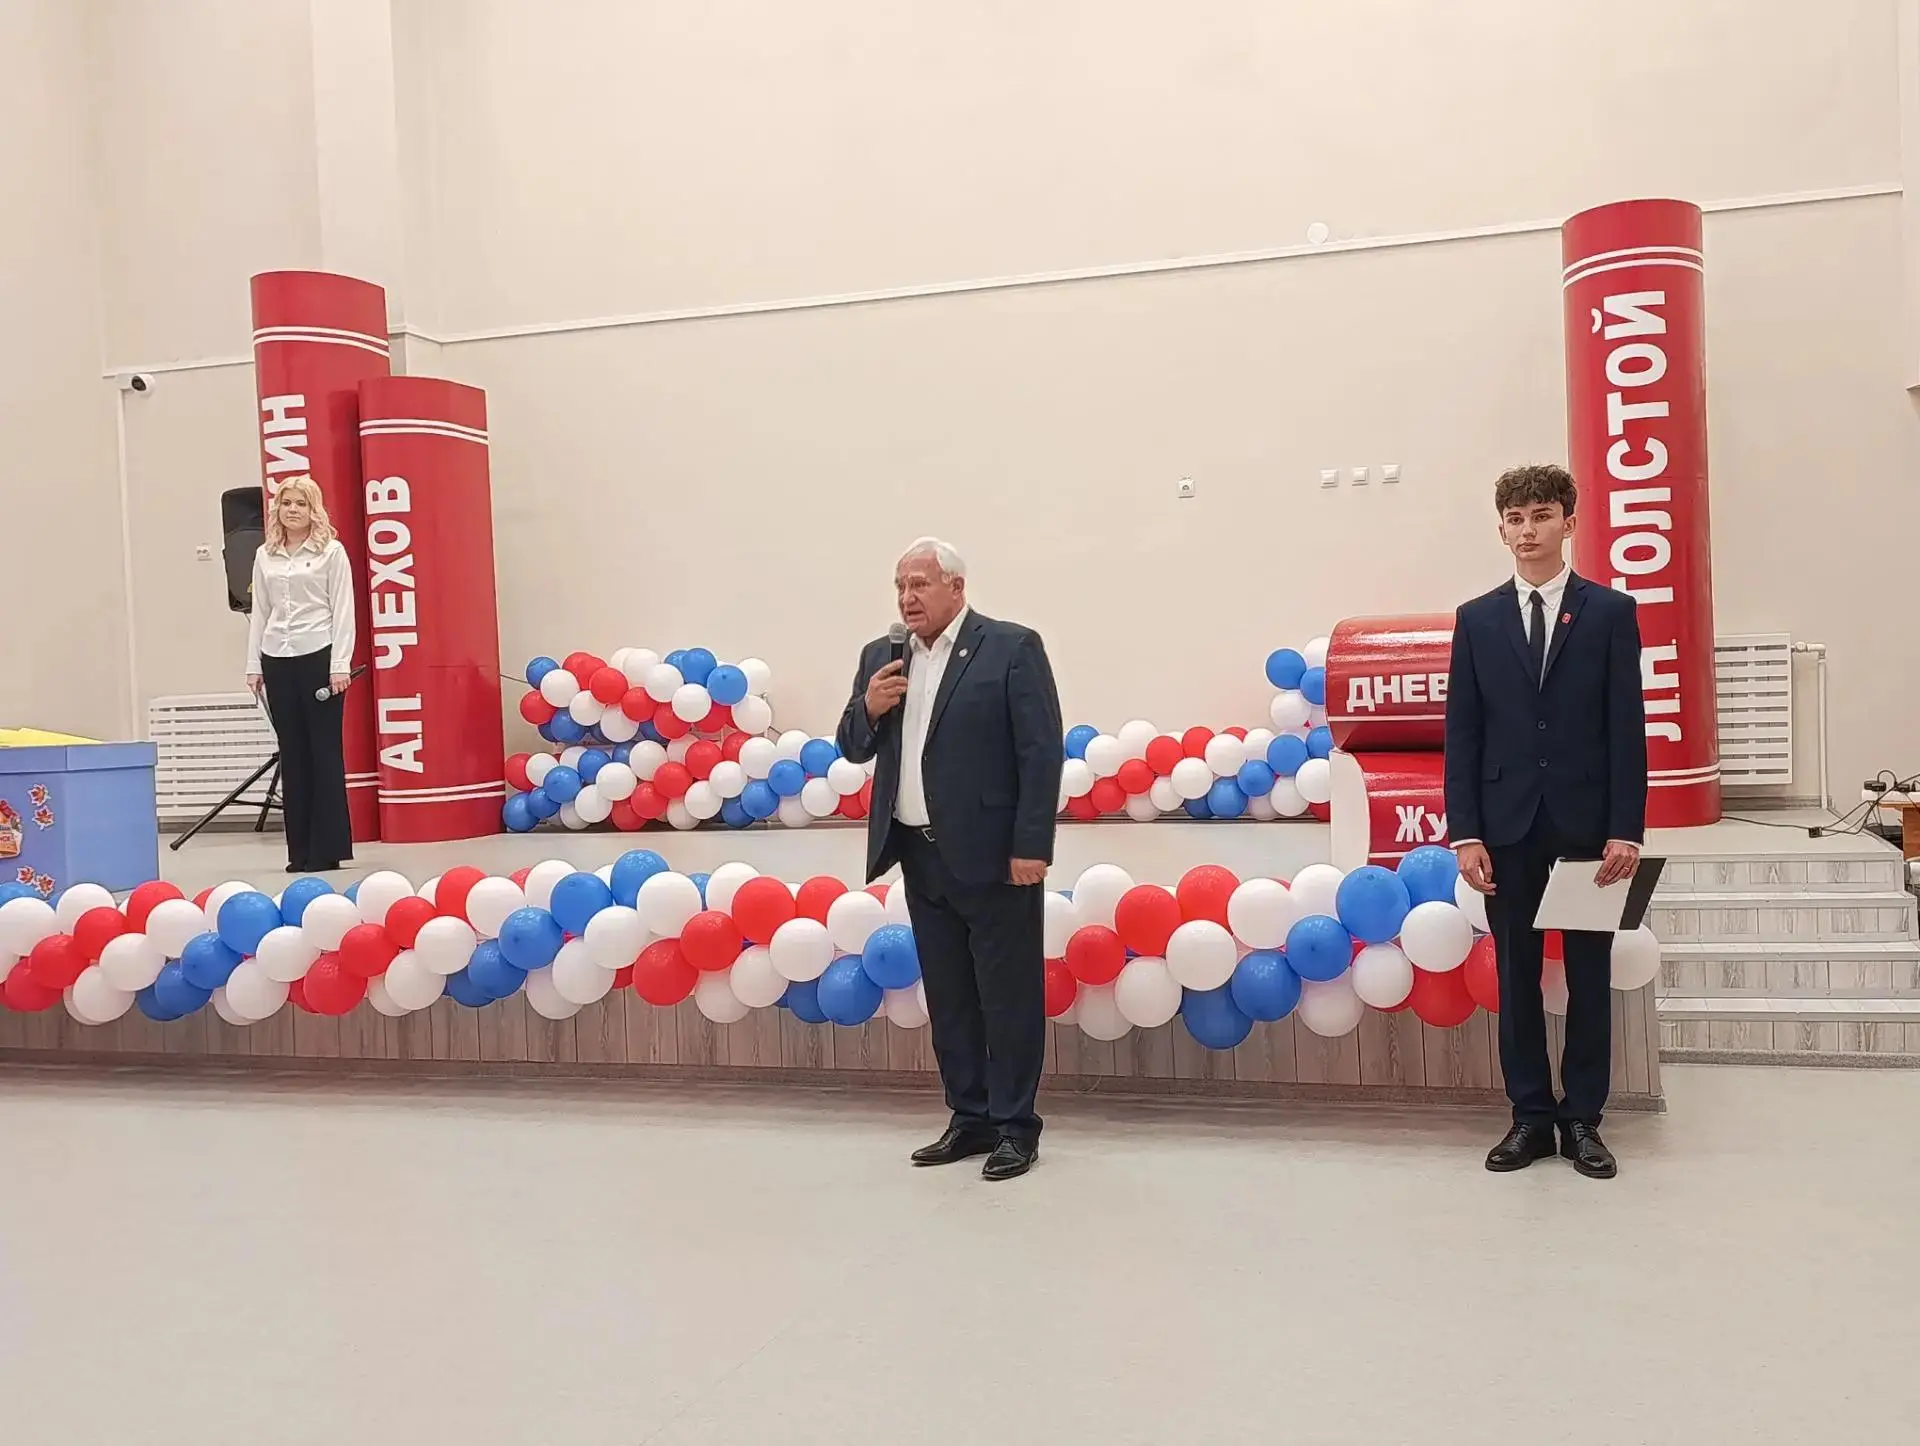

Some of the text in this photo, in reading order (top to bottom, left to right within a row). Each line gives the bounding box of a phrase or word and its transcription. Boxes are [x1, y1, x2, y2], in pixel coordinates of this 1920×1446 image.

[1591, 290, 1674, 605] ТОЛСТОЙ
[365, 476, 424, 774] А.П. ЧЕХОВ
[1346, 672, 1450, 712] ДНЕВ
